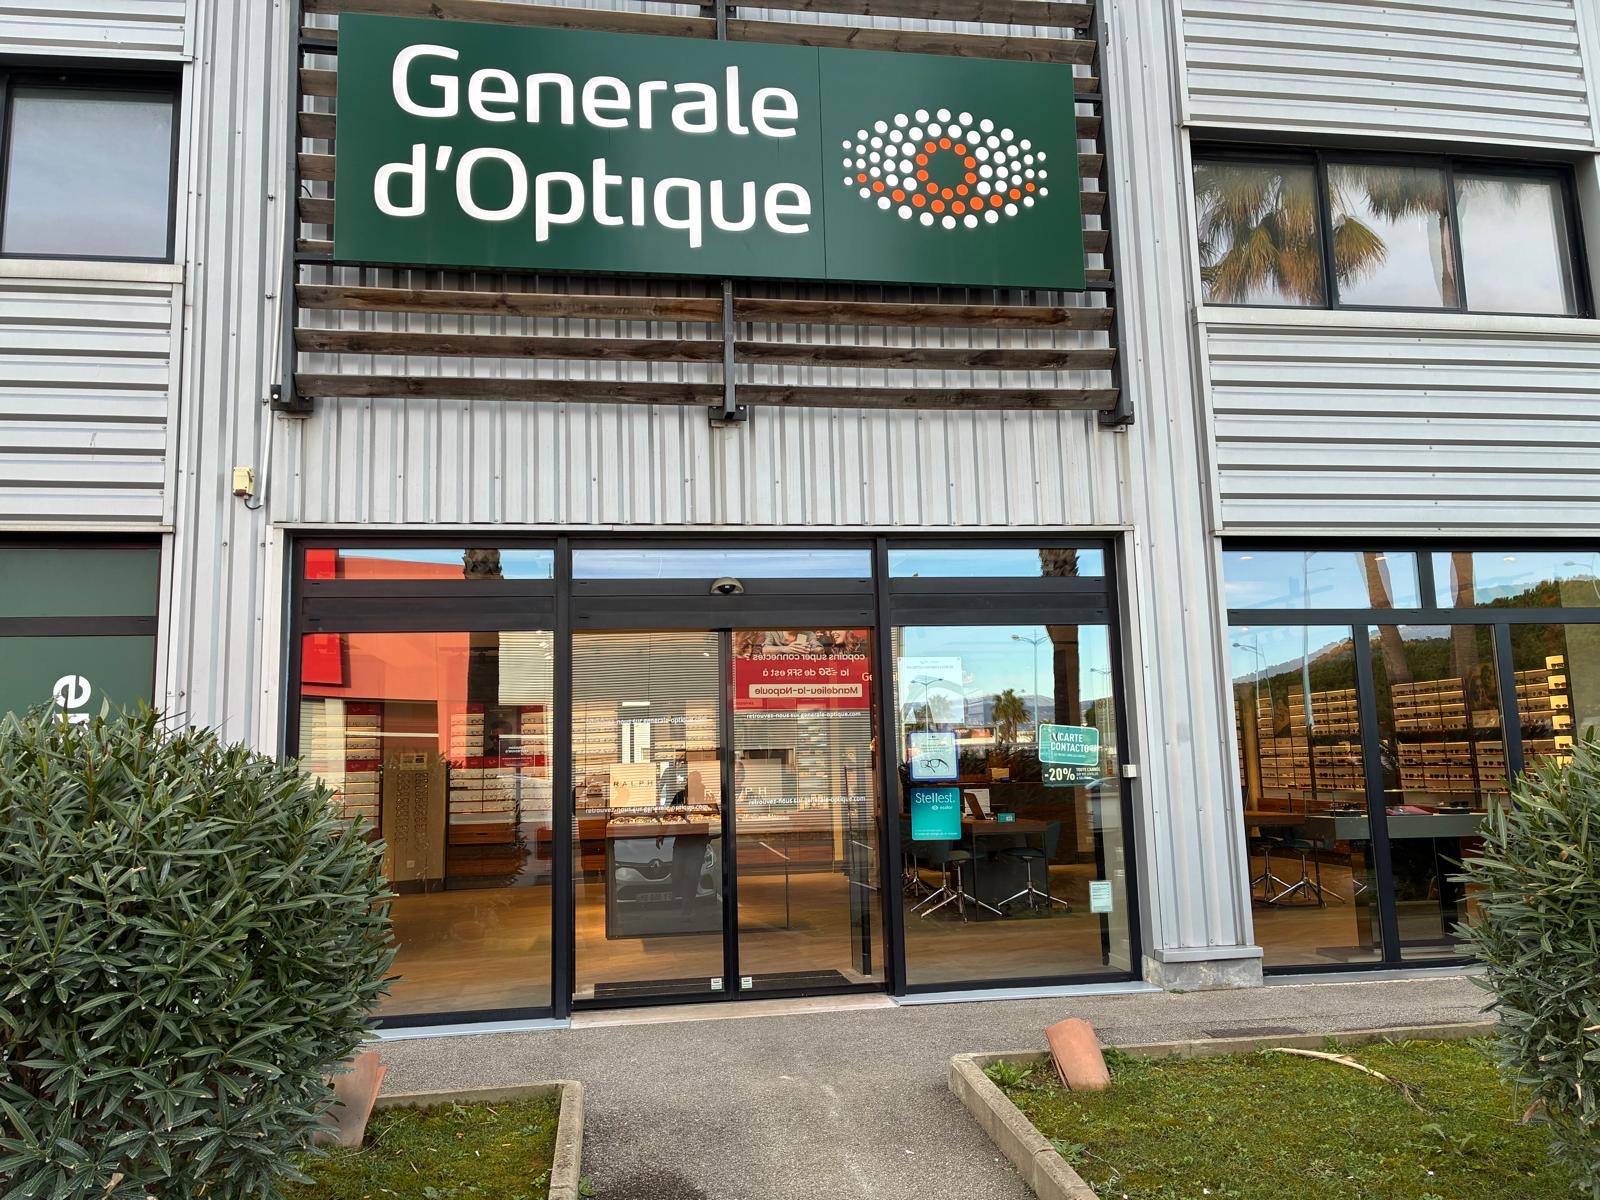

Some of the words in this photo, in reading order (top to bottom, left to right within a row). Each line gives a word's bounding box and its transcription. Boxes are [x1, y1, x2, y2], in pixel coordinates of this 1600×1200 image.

[391, 43, 799, 139] Generale
[1059, 733, 1084, 743] CARTE
[1044, 767, 1076, 781] -20%
